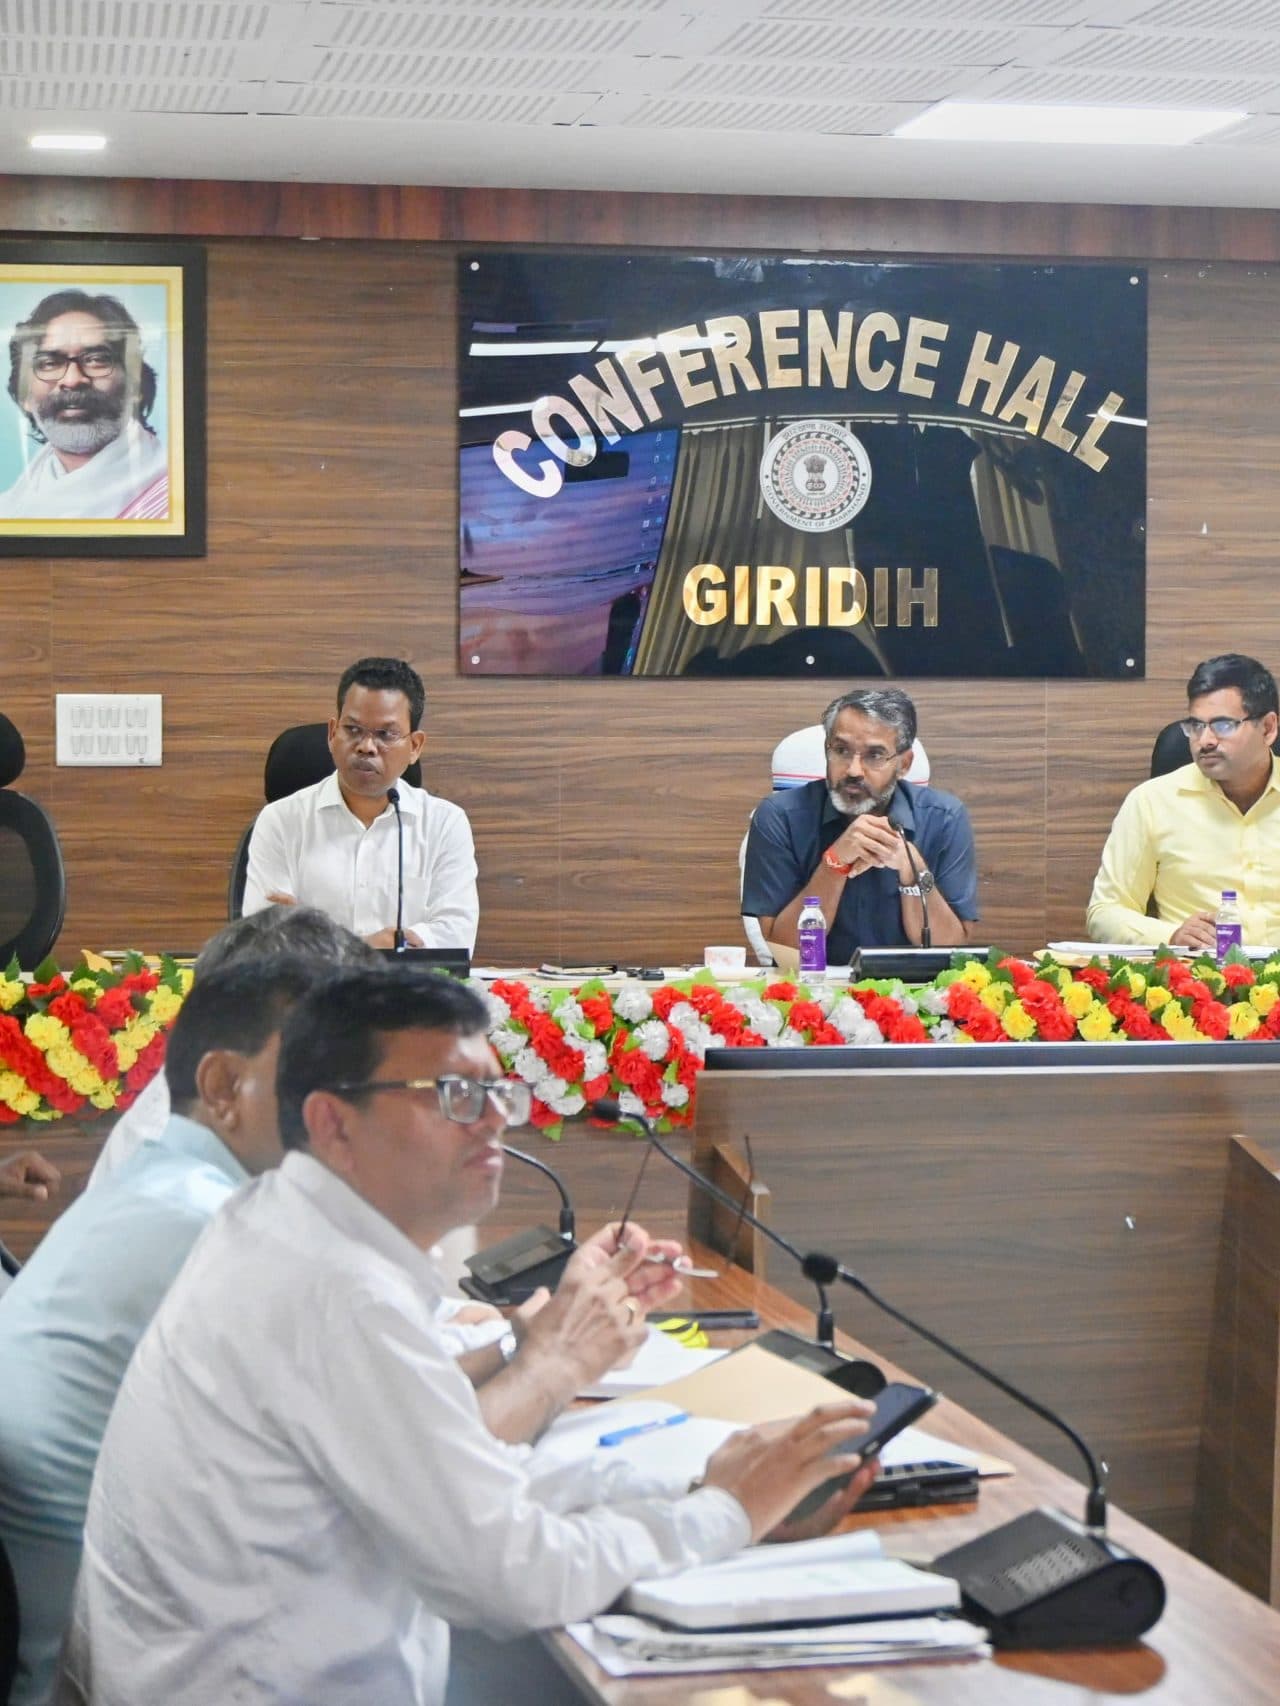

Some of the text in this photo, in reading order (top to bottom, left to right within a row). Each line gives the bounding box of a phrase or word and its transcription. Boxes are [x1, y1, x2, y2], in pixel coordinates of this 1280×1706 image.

[491, 310, 1125, 498] CONFERENCE HALL
[765, 485, 812, 527] GOVERNMENT
[828, 483, 867, 525] JHARKHAND
[682, 564, 939, 627] GIRIDIH
